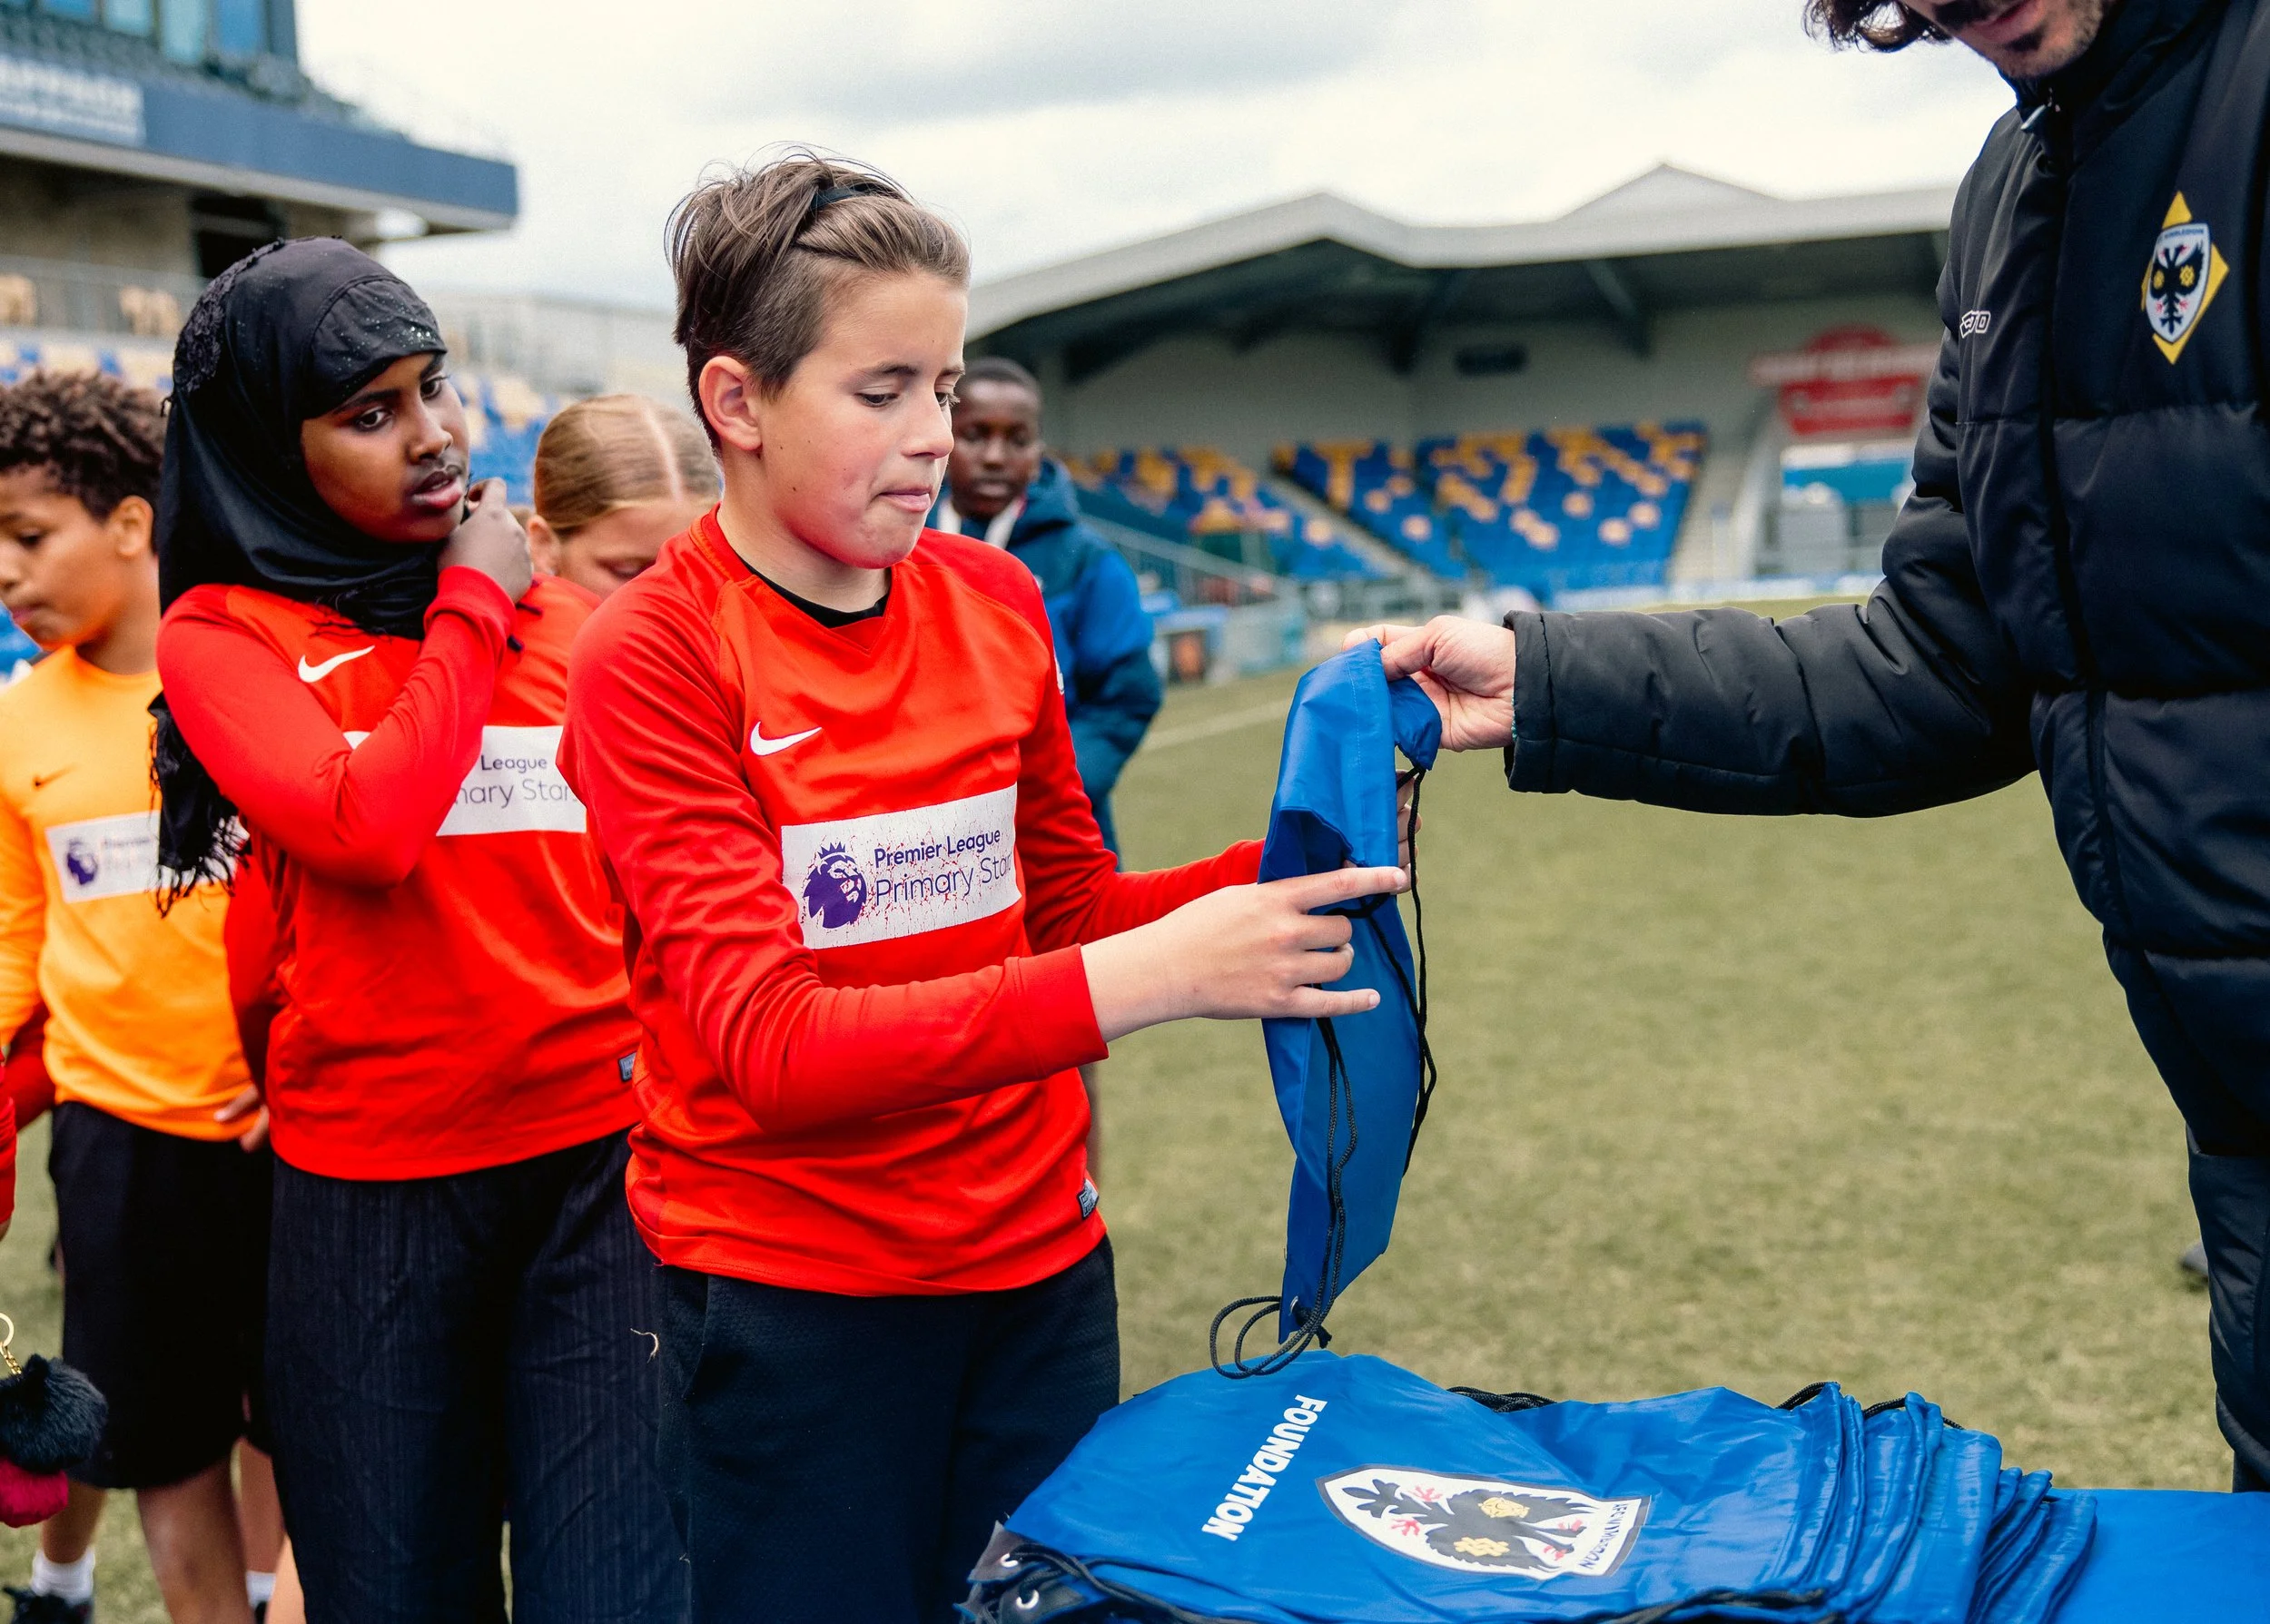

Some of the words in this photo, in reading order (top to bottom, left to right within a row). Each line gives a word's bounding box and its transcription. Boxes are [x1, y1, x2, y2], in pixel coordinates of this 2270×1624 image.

[480, 754, 548, 773] League
[873, 842, 943, 869] Premier
[946, 830, 1001, 854] League
[875, 867, 974, 906] Primary
[1201, 1394, 1327, 1541] FOUNDATION
